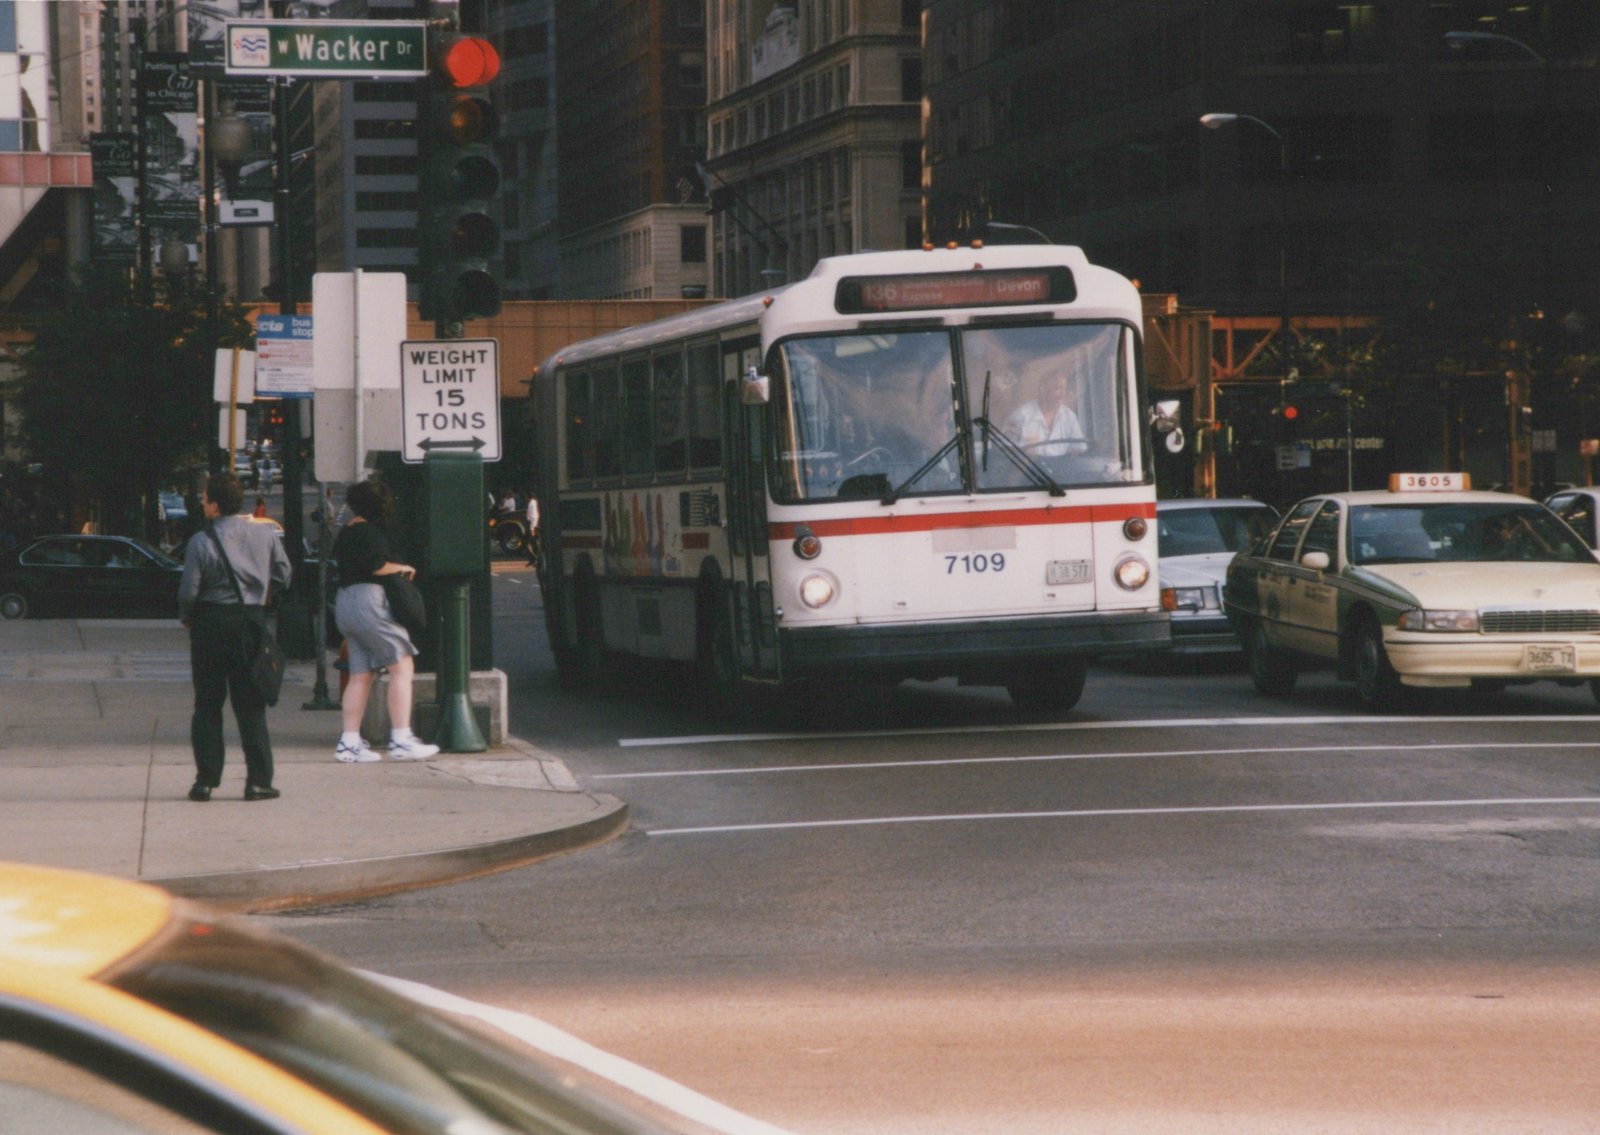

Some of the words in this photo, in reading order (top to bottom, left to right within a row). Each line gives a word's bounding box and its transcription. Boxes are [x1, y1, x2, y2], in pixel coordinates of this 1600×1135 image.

[295, 34, 389, 61] Wacker
[397, 41, 412, 55] Dr
[158, 88, 194, 100] Chicago
[864, 283, 897, 301] 136
[997, 278, 1041, 293] Devon
[902, 290, 943, 302] Express
[259, 321, 284, 333] cta
[292, 316, 311, 328] bus
[411, 350, 488, 366] WEIGHT
[423, 368, 476, 384] LIMIT
[435, 389, 465, 407] 15
[416, 412, 486, 431] TONS
[1407, 475, 1450, 487] 3605
[944, 552, 1005, 575] 7109
[1528, 651, 1554, 664] 3605
